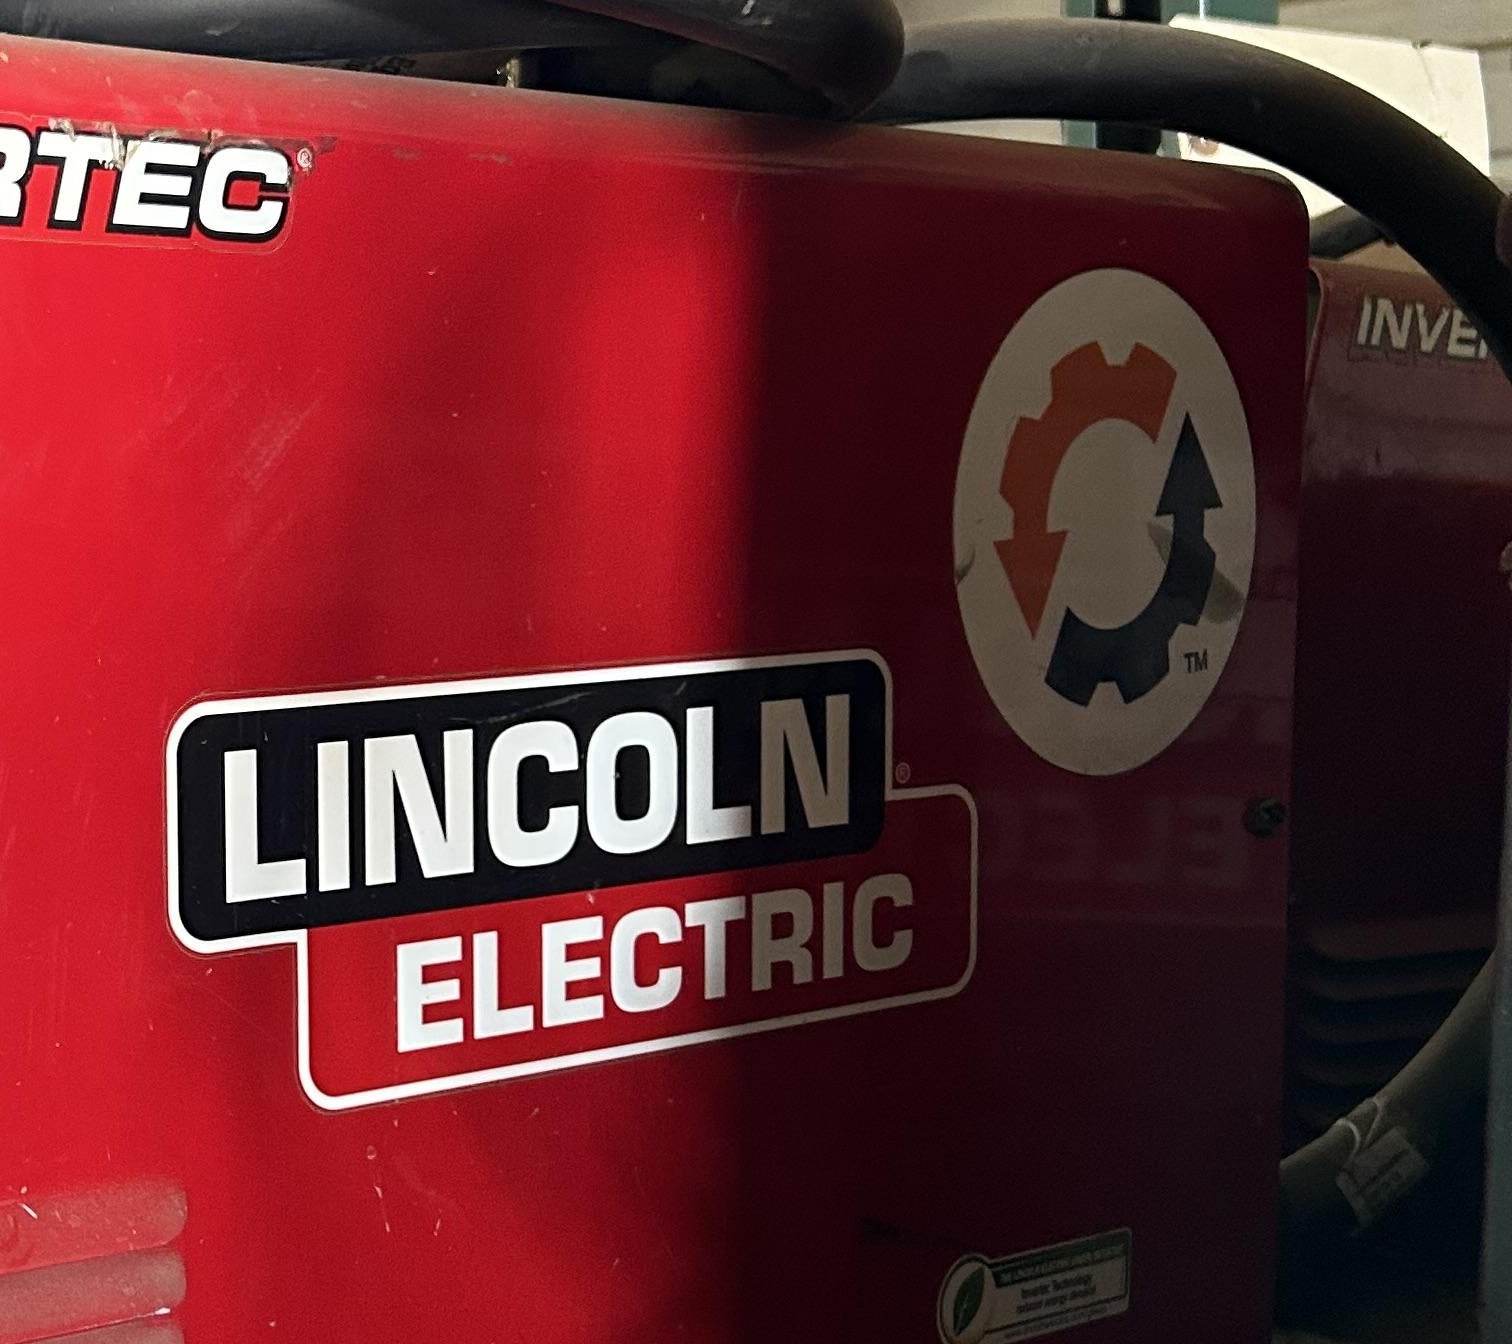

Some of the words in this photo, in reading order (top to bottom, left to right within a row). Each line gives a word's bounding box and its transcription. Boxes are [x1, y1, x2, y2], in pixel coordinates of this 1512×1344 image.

[1183, 651, 1209, 674] TM
[223, 692, 851, 905] LINCOLN
[396, 871, 915, 1054] ELECTRIC
